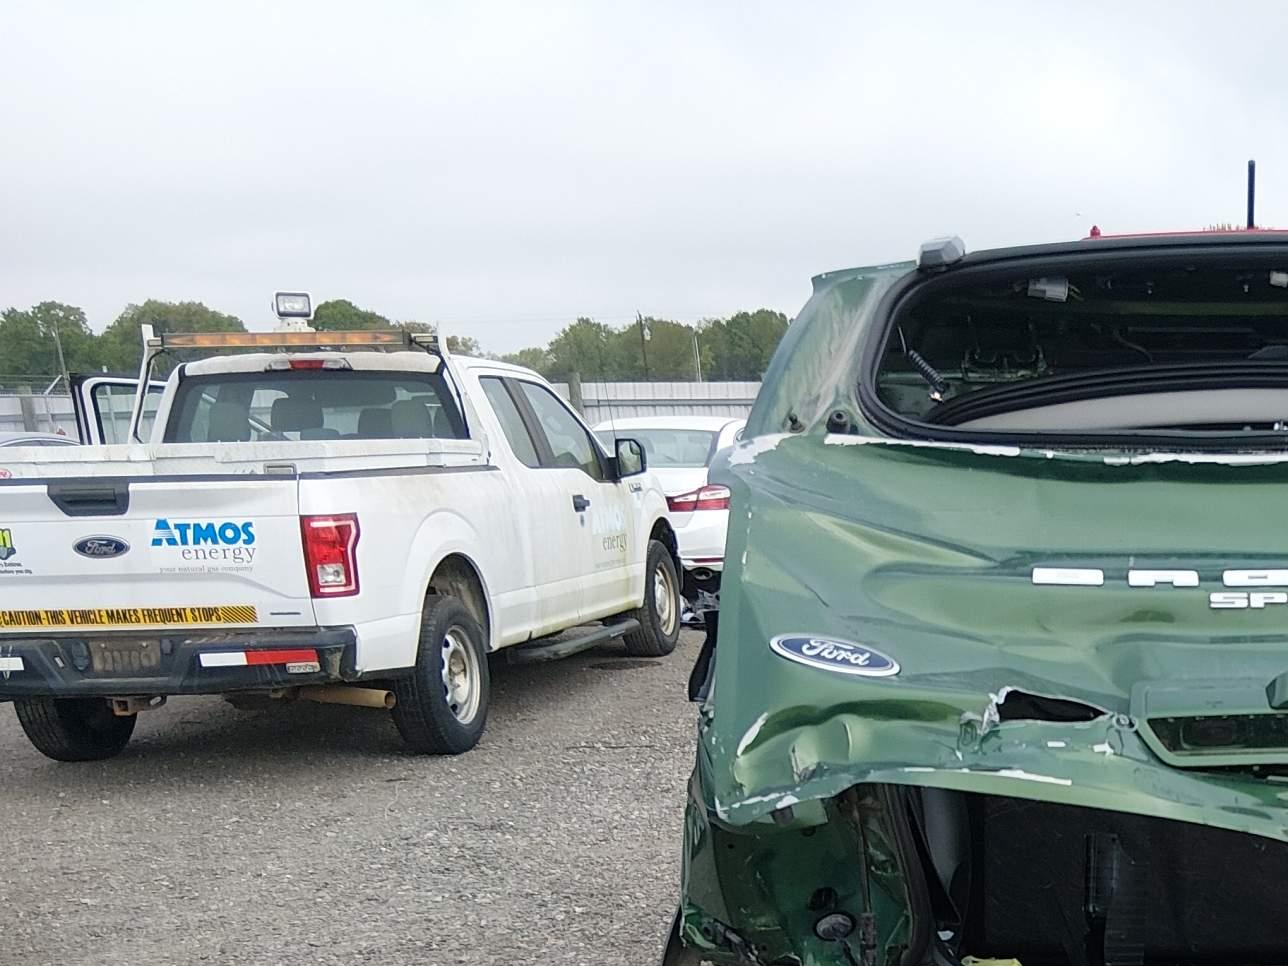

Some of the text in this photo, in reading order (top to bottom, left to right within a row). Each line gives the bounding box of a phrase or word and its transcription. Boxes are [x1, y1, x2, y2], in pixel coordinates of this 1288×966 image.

[151, 518, 255, 546] ATMOS
[181, 547, 256, 563] energy
[67, 609, 106, 625] VEHICLE
[106, 608, 140, 624] MAKES
[141, 607, 189, 624] FREQUENT
[190, 607, 222, 623] STOPS
